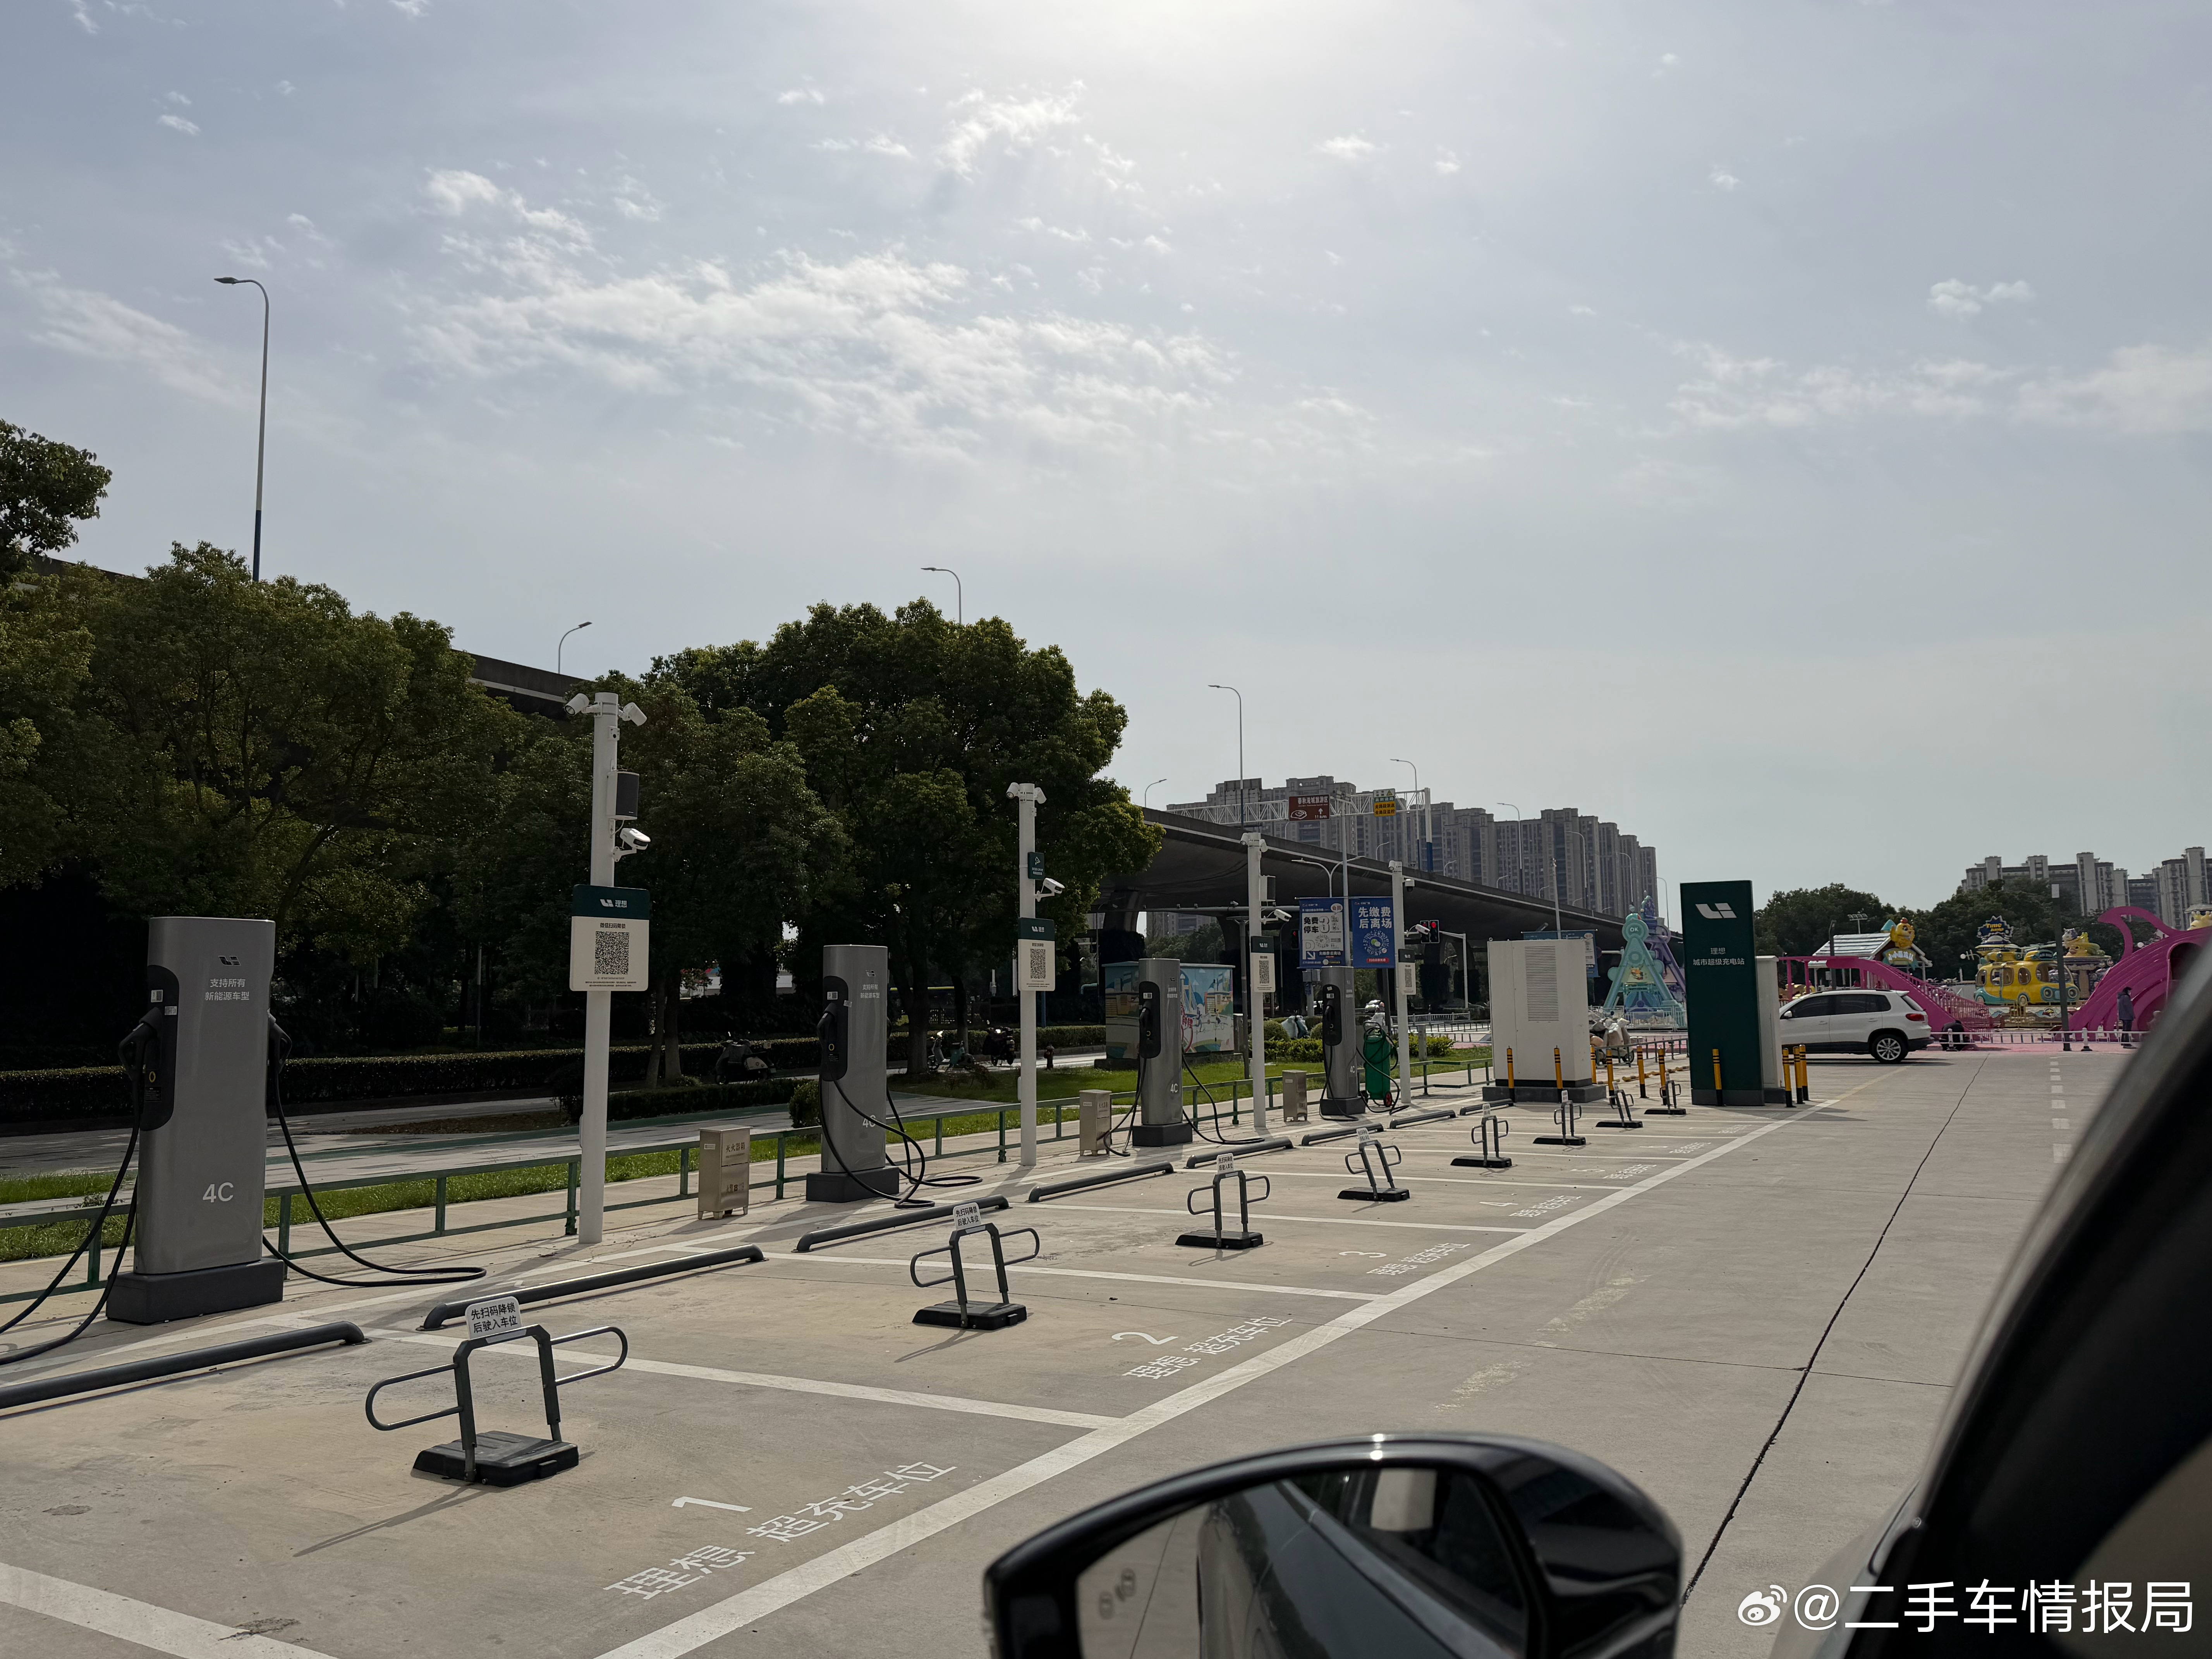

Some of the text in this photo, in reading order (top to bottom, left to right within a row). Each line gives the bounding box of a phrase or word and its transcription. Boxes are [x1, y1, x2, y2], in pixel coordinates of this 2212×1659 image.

[615, 900, 627, 908] 理想
[1358, 907, 1391, 917] 先缴费
[1359, 918, 1392, 929] 后离场
[1693, 958, 1745, 966] 城市超级充电站
[210, 978, 246, 988] 支持所有
[204, 991, 249, 1001] 新能源车型
[1170, 1083, 1178, 1093] 4C
[862, 1115, 876, 1128] 4C
[202, 1182, 234, 1203] 4C
[471, 1302, 516, 1321] 先扫码降锁
[474, 1315, 518, 1333] 后驶入车位
[1111, 1331, 1179, 1345] 2
[1121, 1316, 1293, 1379] 理想 超充车位
[672, 1496, 753, 1512] 1
[603, 1461, 958, 1600] 理想 超充车位
